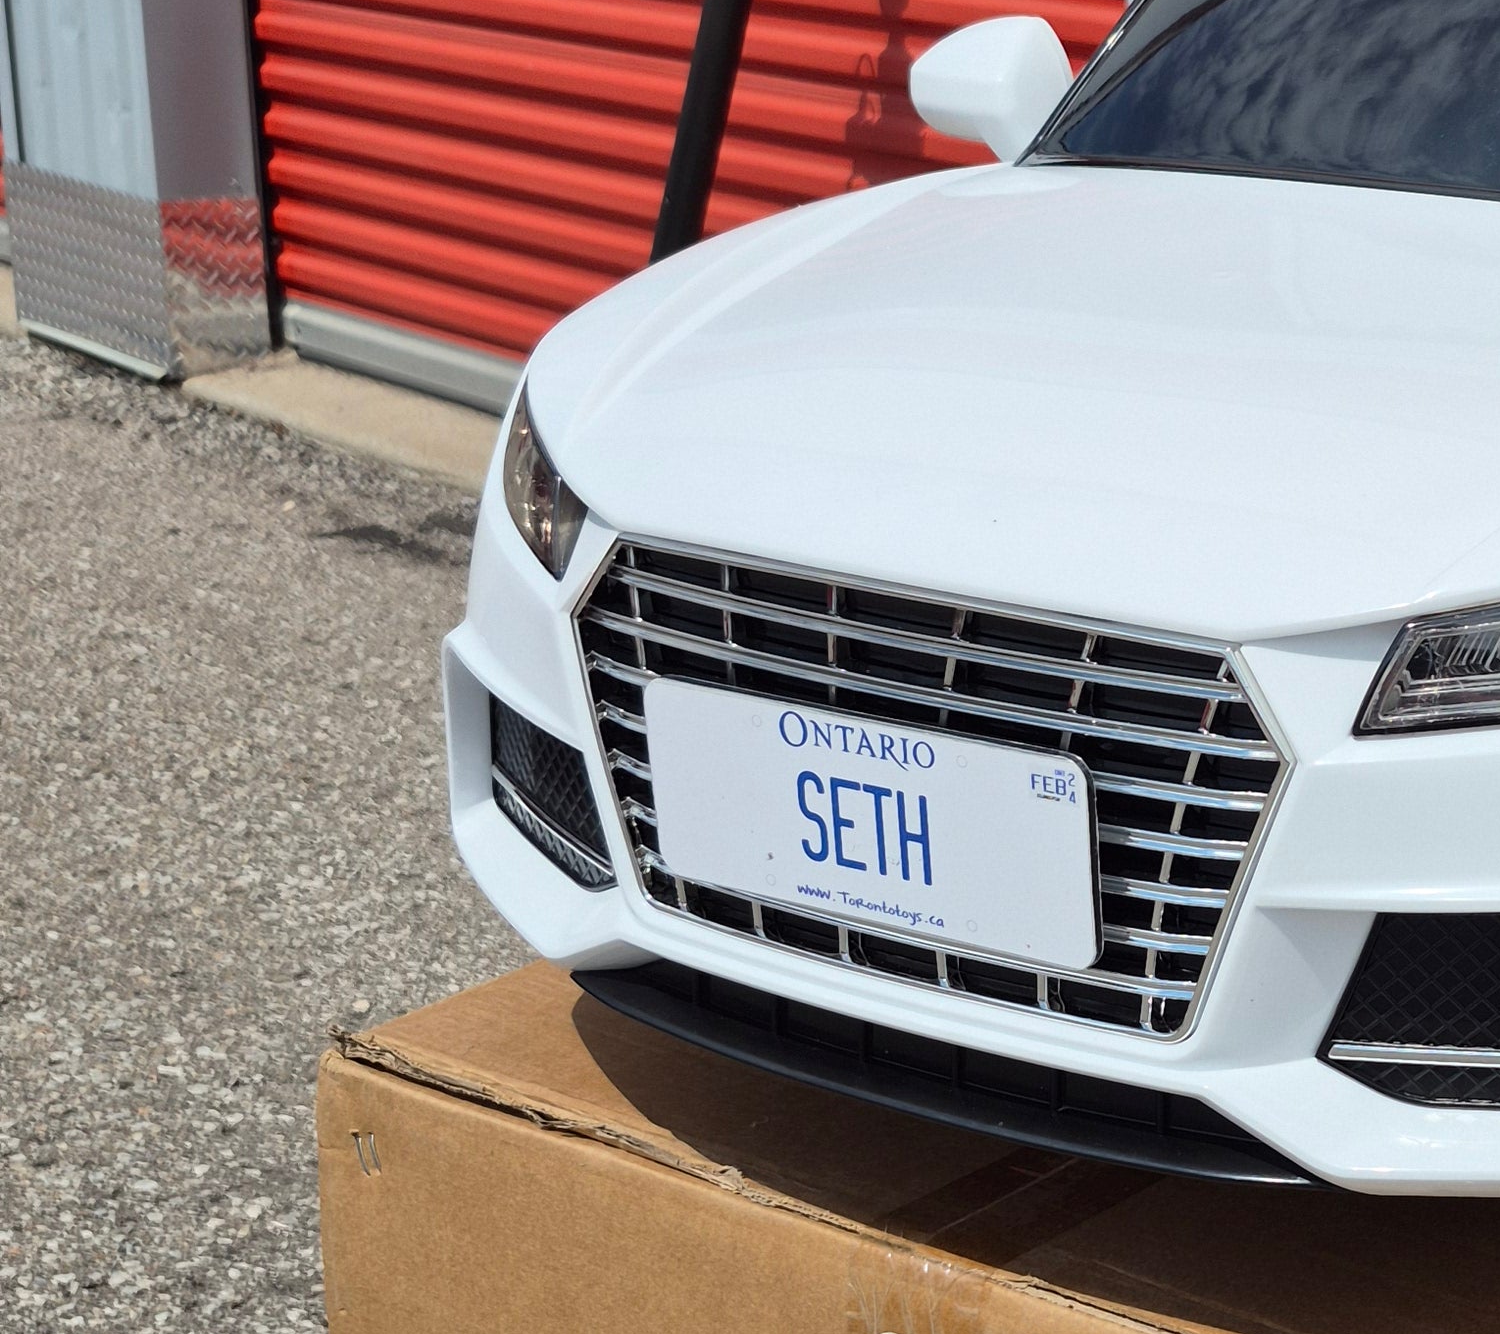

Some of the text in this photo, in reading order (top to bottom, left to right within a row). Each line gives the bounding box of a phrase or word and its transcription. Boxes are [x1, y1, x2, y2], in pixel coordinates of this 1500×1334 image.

[779, 711, 935, 771] ONTARIO
[1031, 773, 1066, 796] FEB
[796, 770, 933, 886] SETH
